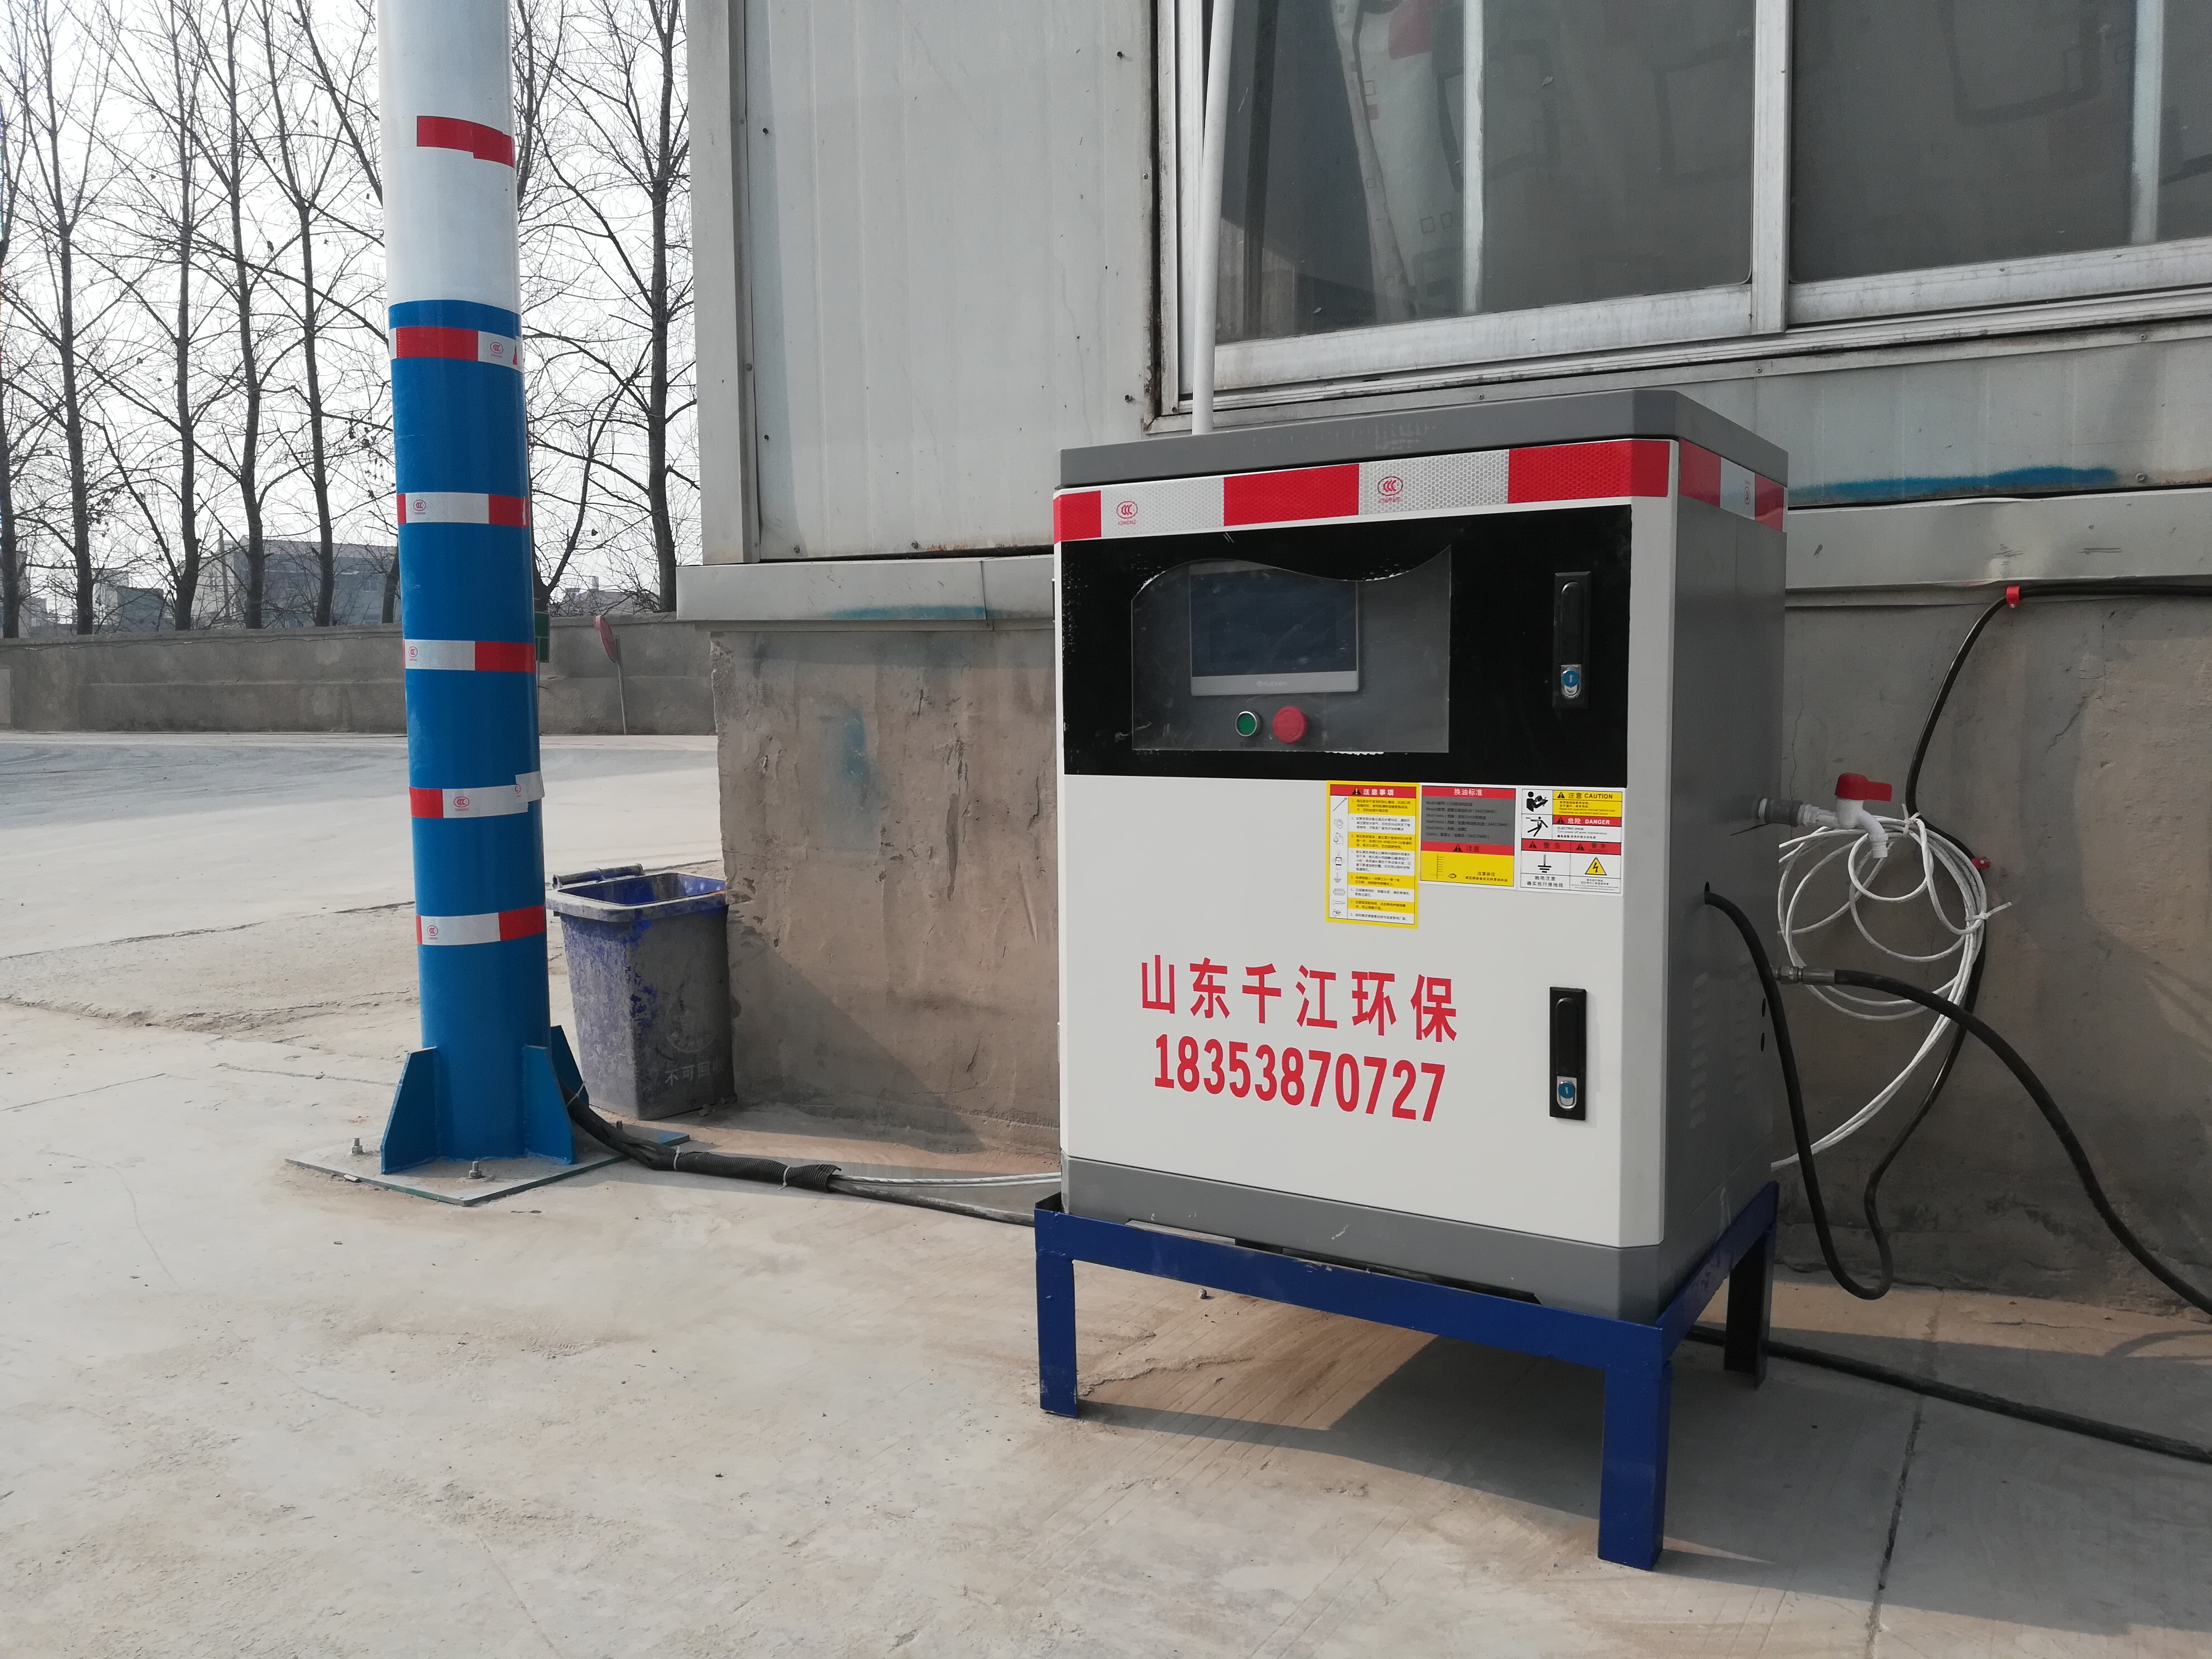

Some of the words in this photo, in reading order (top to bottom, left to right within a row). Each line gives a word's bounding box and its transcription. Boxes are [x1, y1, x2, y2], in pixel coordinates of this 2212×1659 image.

[1142, 954, 1457, 1042] 山东千江环保
[1154, 1034, 1445, 1122] 18353870727
